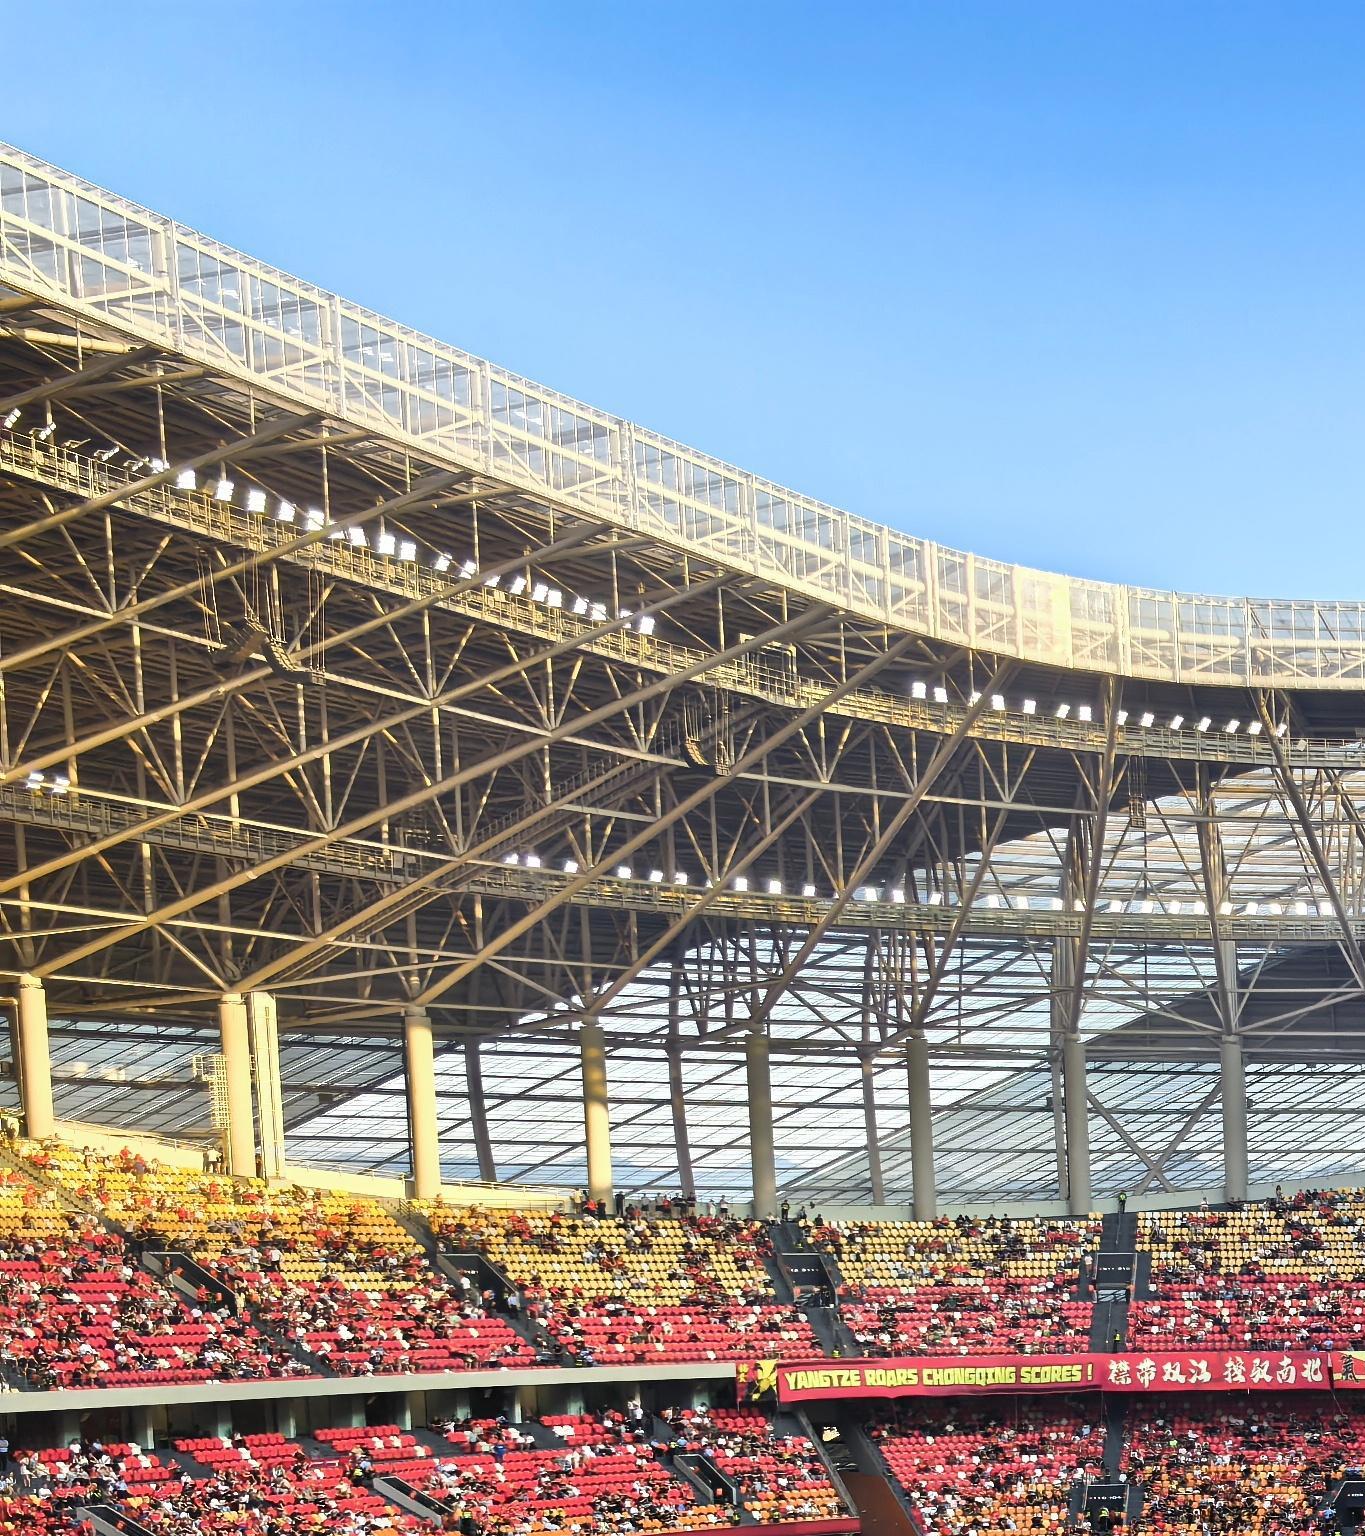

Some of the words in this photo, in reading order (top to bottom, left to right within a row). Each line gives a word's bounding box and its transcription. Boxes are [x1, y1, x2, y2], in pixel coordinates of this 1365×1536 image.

[785, 1368, 861, 1390] YANGTZE
[864, 1368, 919, 1388] ROARS
[922, 1366, 1016, 1387] CHONGQING
[1020, 1364, 1082, 1384] SCORES
